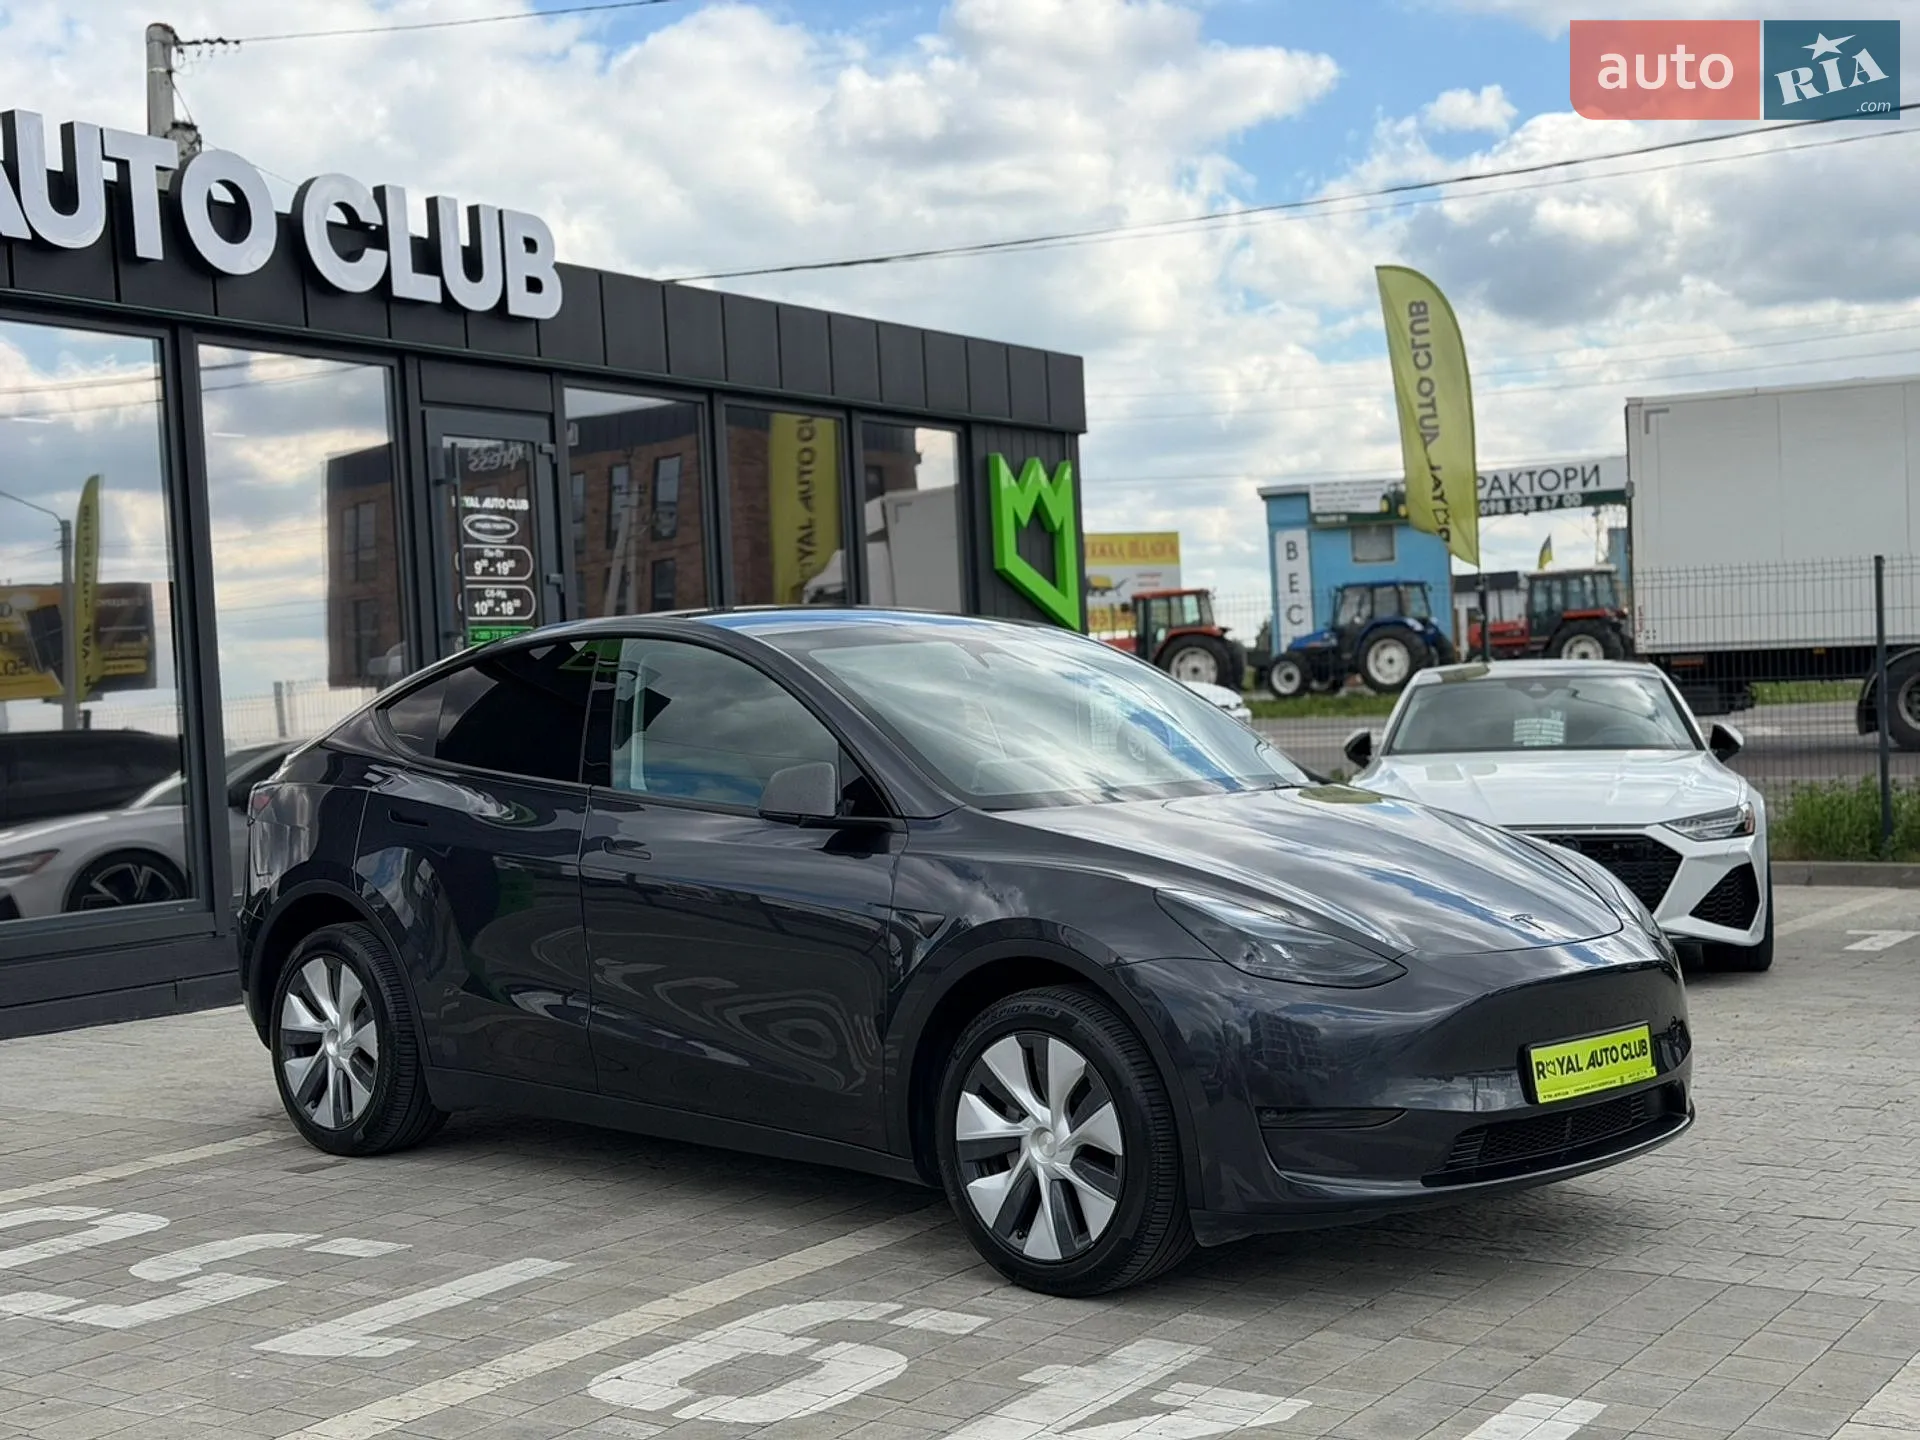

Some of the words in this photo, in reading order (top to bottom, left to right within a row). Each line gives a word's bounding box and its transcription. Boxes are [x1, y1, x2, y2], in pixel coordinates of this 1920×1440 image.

[293, 172, 563, 320] CLUB
[482, 497, 505, 510] AUTO
[506, 498, 529, 511] CLUB
[1563, 493, 1582, 507] 00
[1586, 1046, 1619, 1071] AUTO
[1621, 1038, 1649, 1062] CLUB
